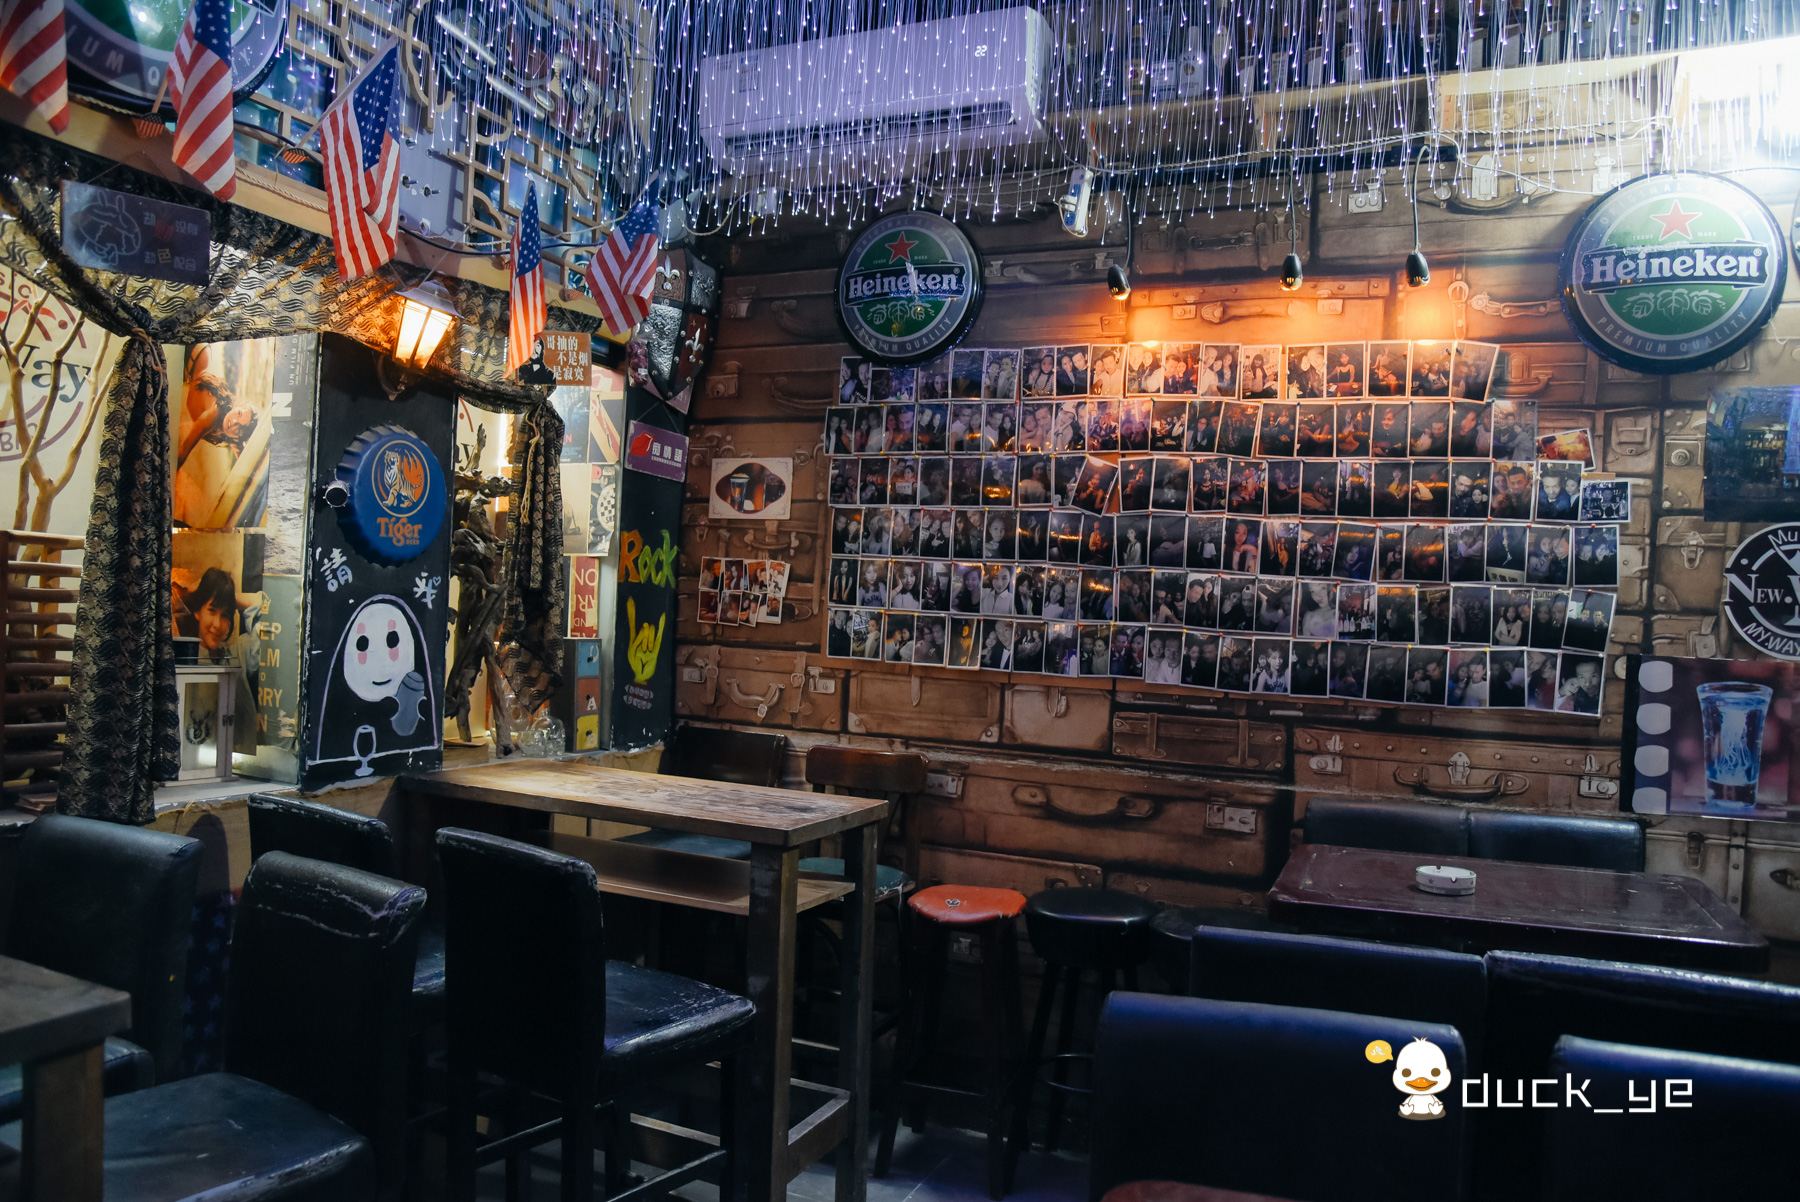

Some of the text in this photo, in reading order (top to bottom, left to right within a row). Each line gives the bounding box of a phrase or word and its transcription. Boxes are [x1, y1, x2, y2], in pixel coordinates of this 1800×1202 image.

[975, 45, 988, 57] 22
[1600, 182, 1682, 226] ORIGINAL
[1591, 249, 1760, 284] Heineken
[848, 269, 959, 299] Heineken
[546, 334, 578, 351] 哥抽的
[906, 317, 953, 350] QUALITY
[1597, 311, 1749, 353] PREMIUM QUALITY
[377, 517, 423, 547] Tiger
[618, 528, 679, 589] Rock
